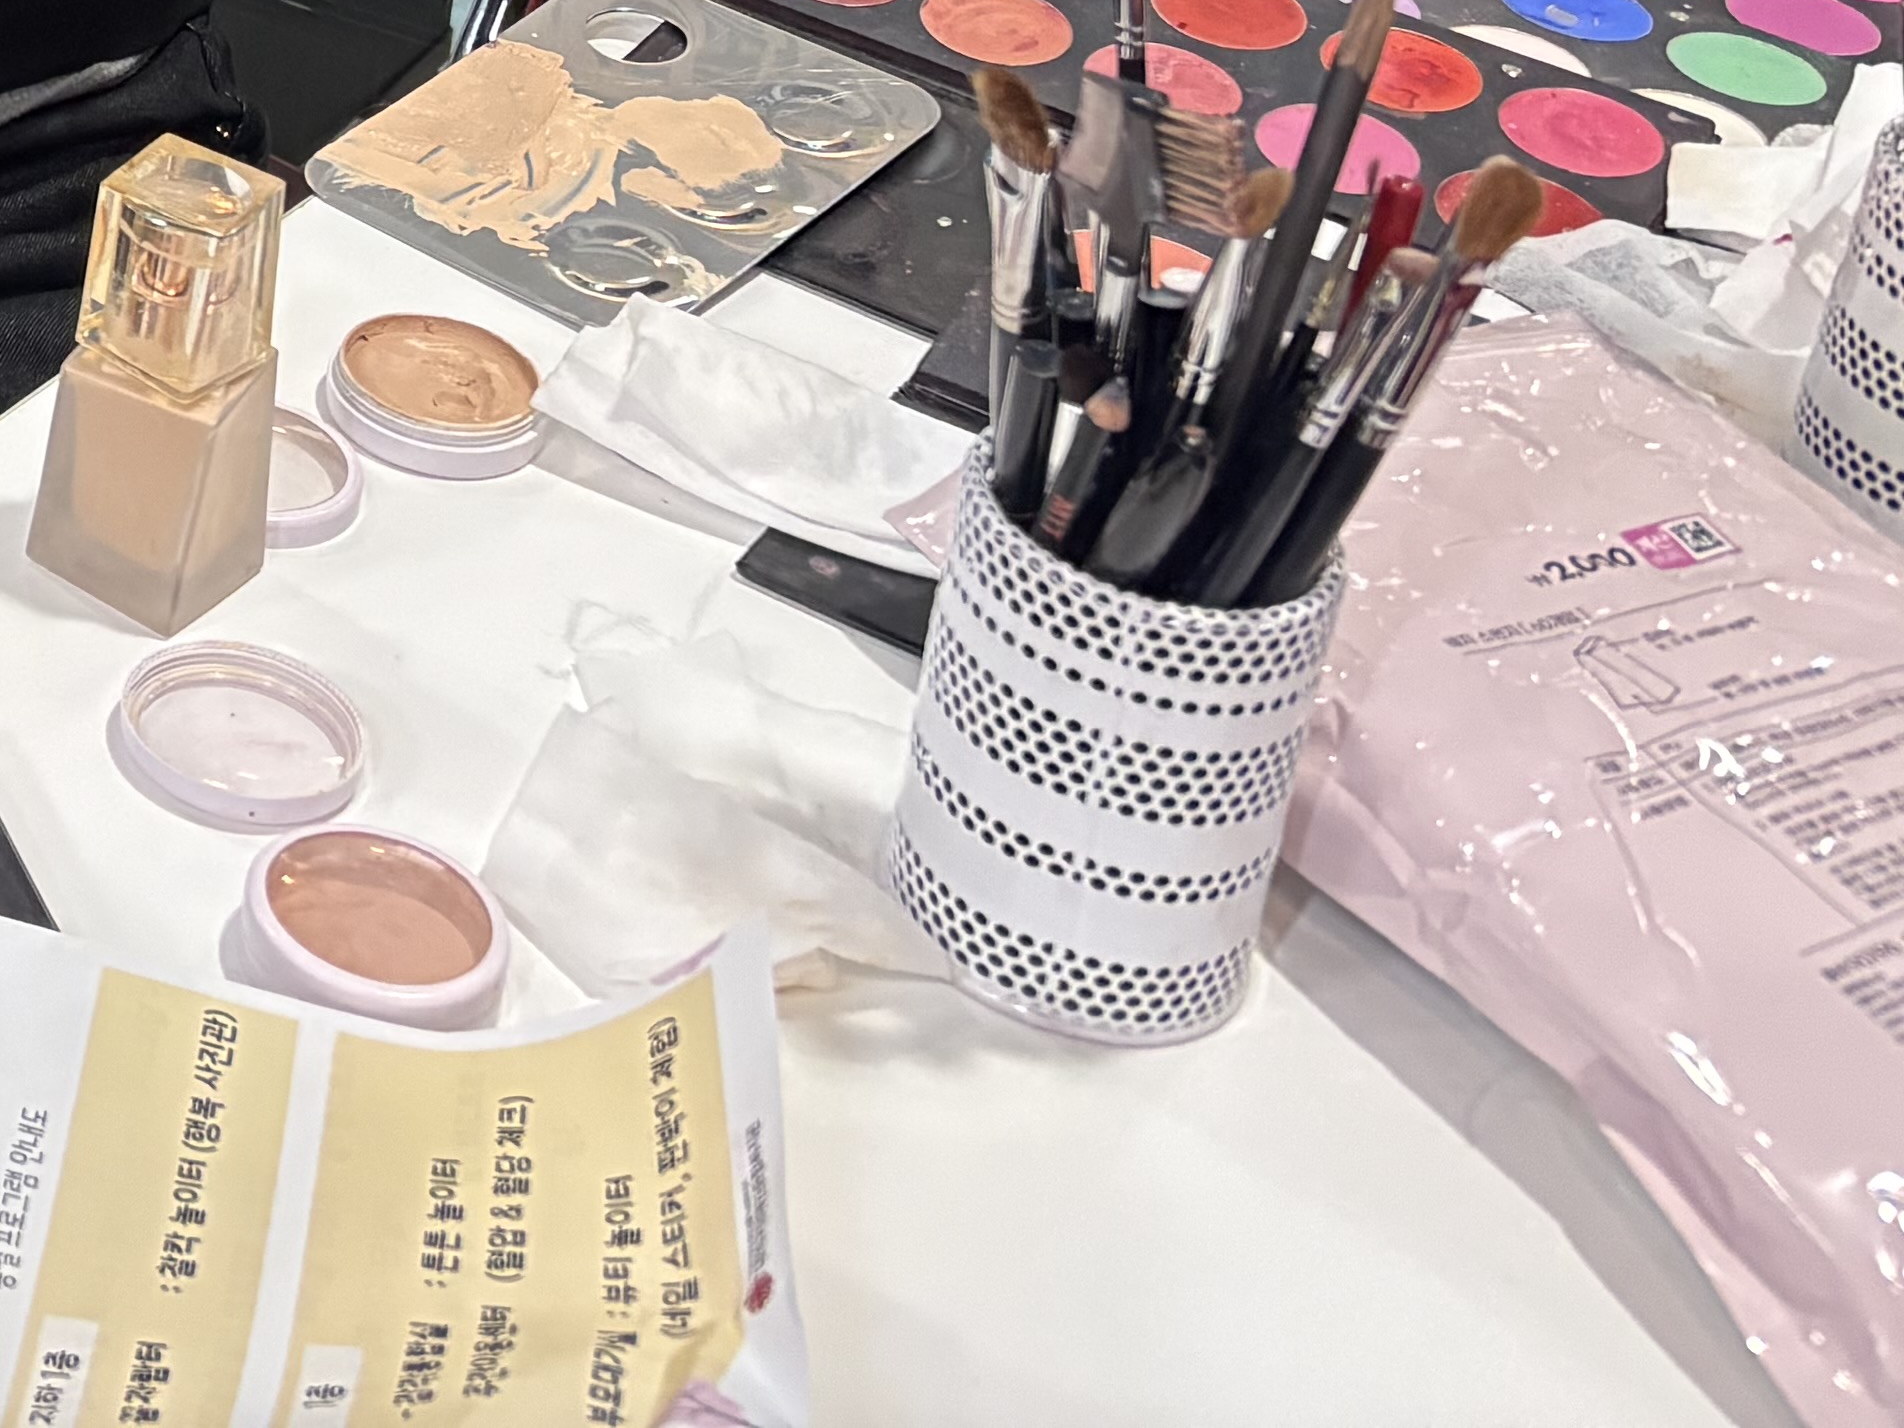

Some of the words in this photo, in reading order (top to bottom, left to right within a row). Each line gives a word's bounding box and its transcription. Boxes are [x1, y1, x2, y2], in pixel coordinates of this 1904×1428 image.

[193, 1008, 239, 1092] 사진관)
[645, 1015, 680, 1086] 체험)
[9, 1106, 48, 1167] 안내도
[181, 1096, 226, 1155] (행복
[495, 1095, 536, 1148] 체크)
[651, 1087, 691, 1175] 판박이
[169, 1156, 207, 1227] 놀이터
[427, 1157, 465, 1224] 놀이터
[491, 1153, 532, 1197] 혈당
[489, 1204, 524, 1224] &
[603, 1173, 642, 1247] 놀이터
[658, 1172, 693, 1270] 스티커,
[155, 1231, 203, 1280] 찰칵
[420, 1228, 462, 1275] 튼튼
[483, 1226, 527, 1284] (혈압
[601, 1255, 641, 1304] 뷰티
[658, 1275, 701, 1340] (네일
[40, 1349, 80, 1380] 1층
[585, 1328, 639, 1428] 부모대기실
[28, 1378, 64, 1427] 지하
[302, 1384, 349, 1410] 1층
